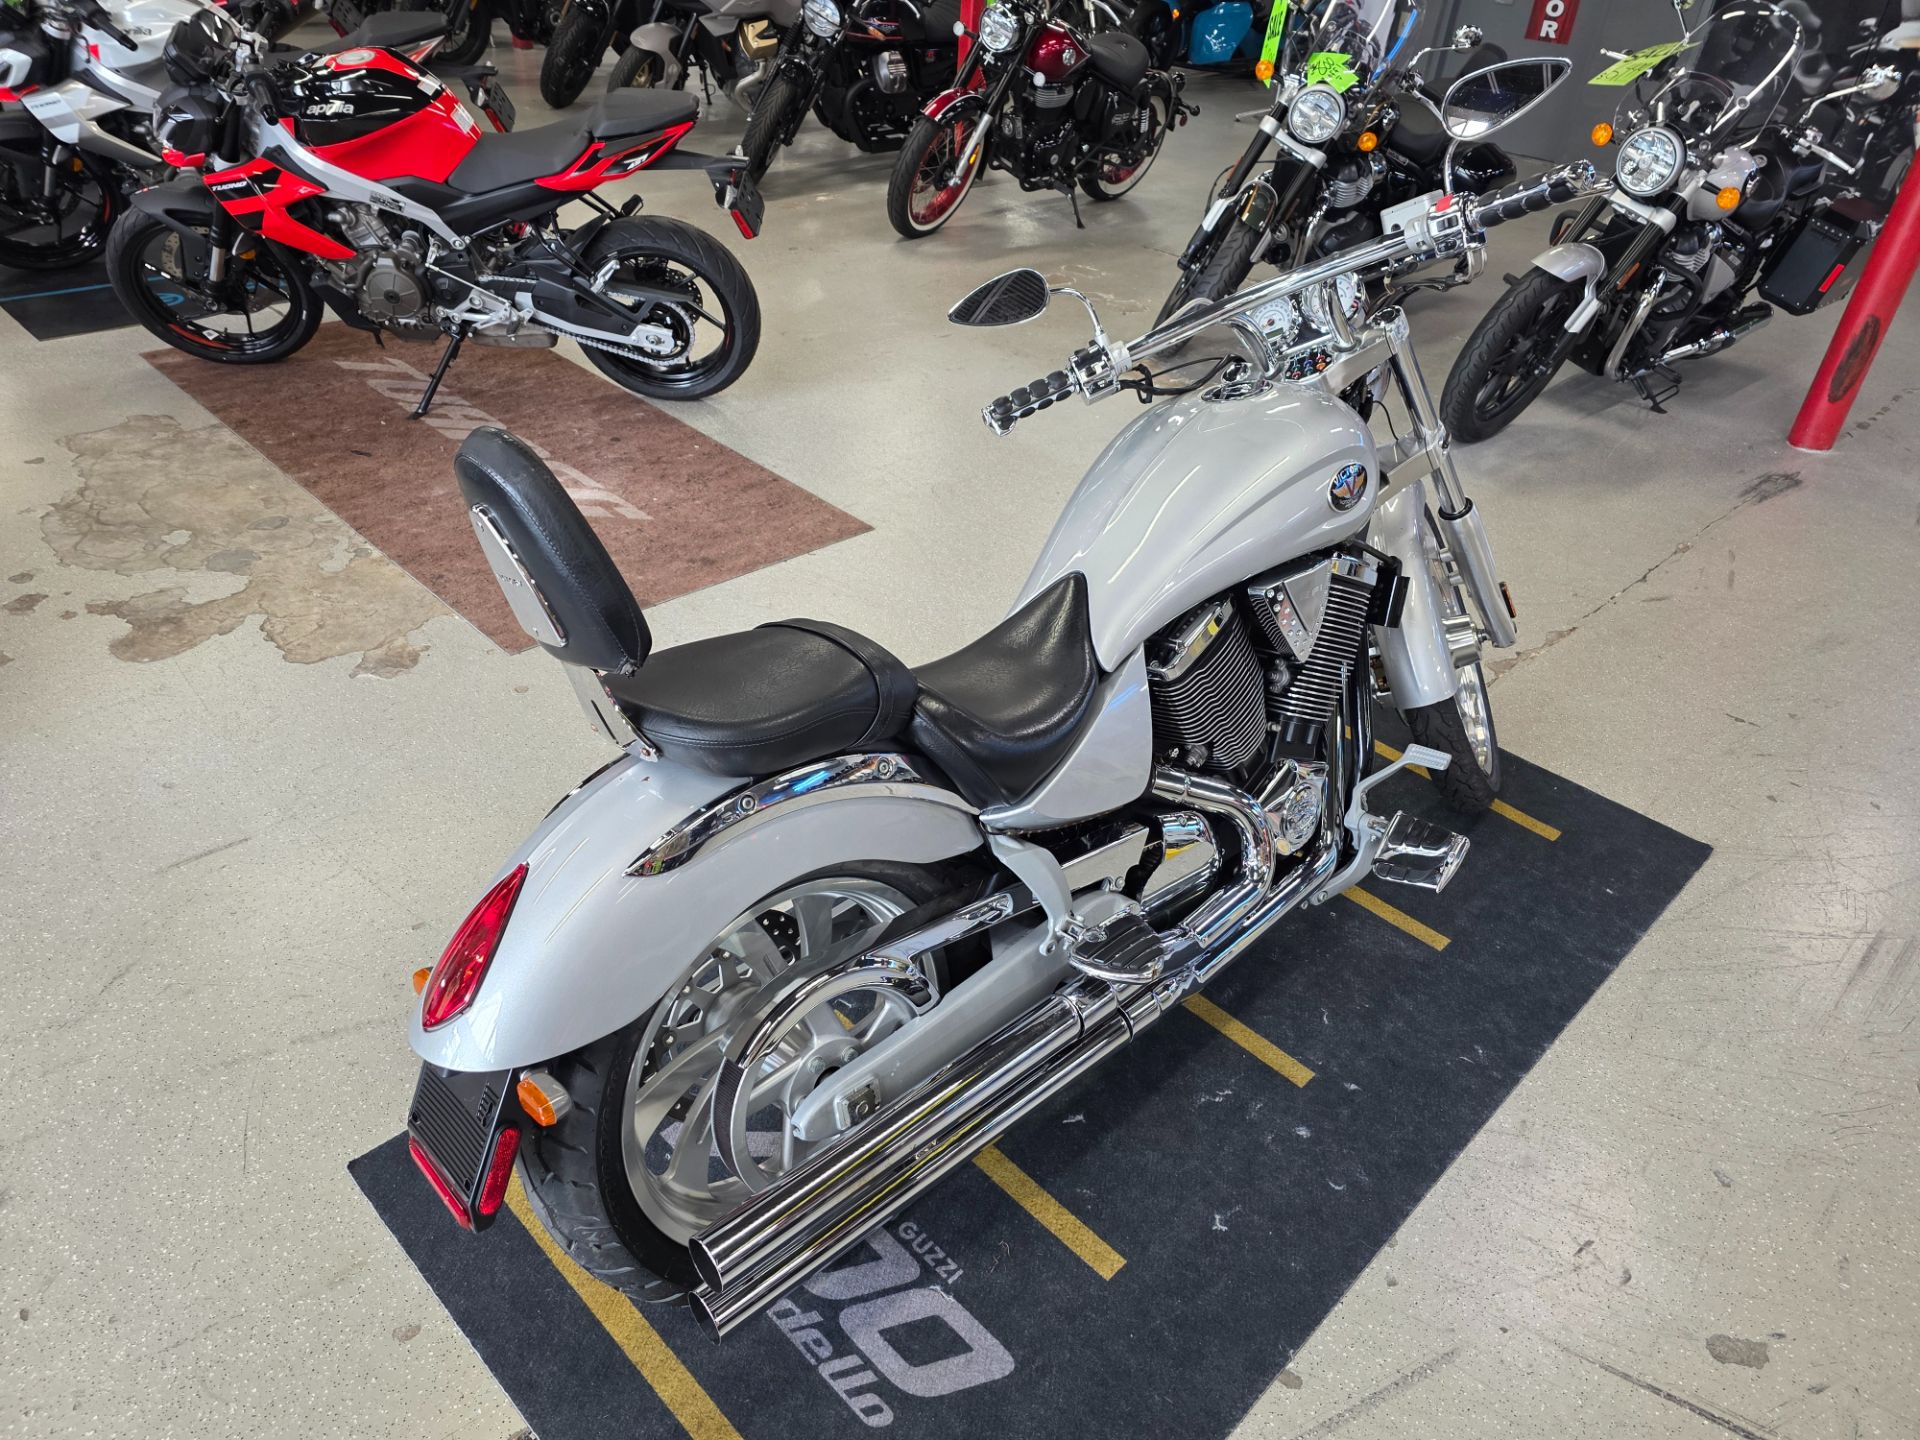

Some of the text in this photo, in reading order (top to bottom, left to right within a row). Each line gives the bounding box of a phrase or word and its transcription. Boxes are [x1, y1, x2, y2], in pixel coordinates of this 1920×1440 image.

[211, 181, 248, 192] TUONO
[898, 1221, 965, 1285] GUZZI
[766, 1297, 895, 1428] dello
